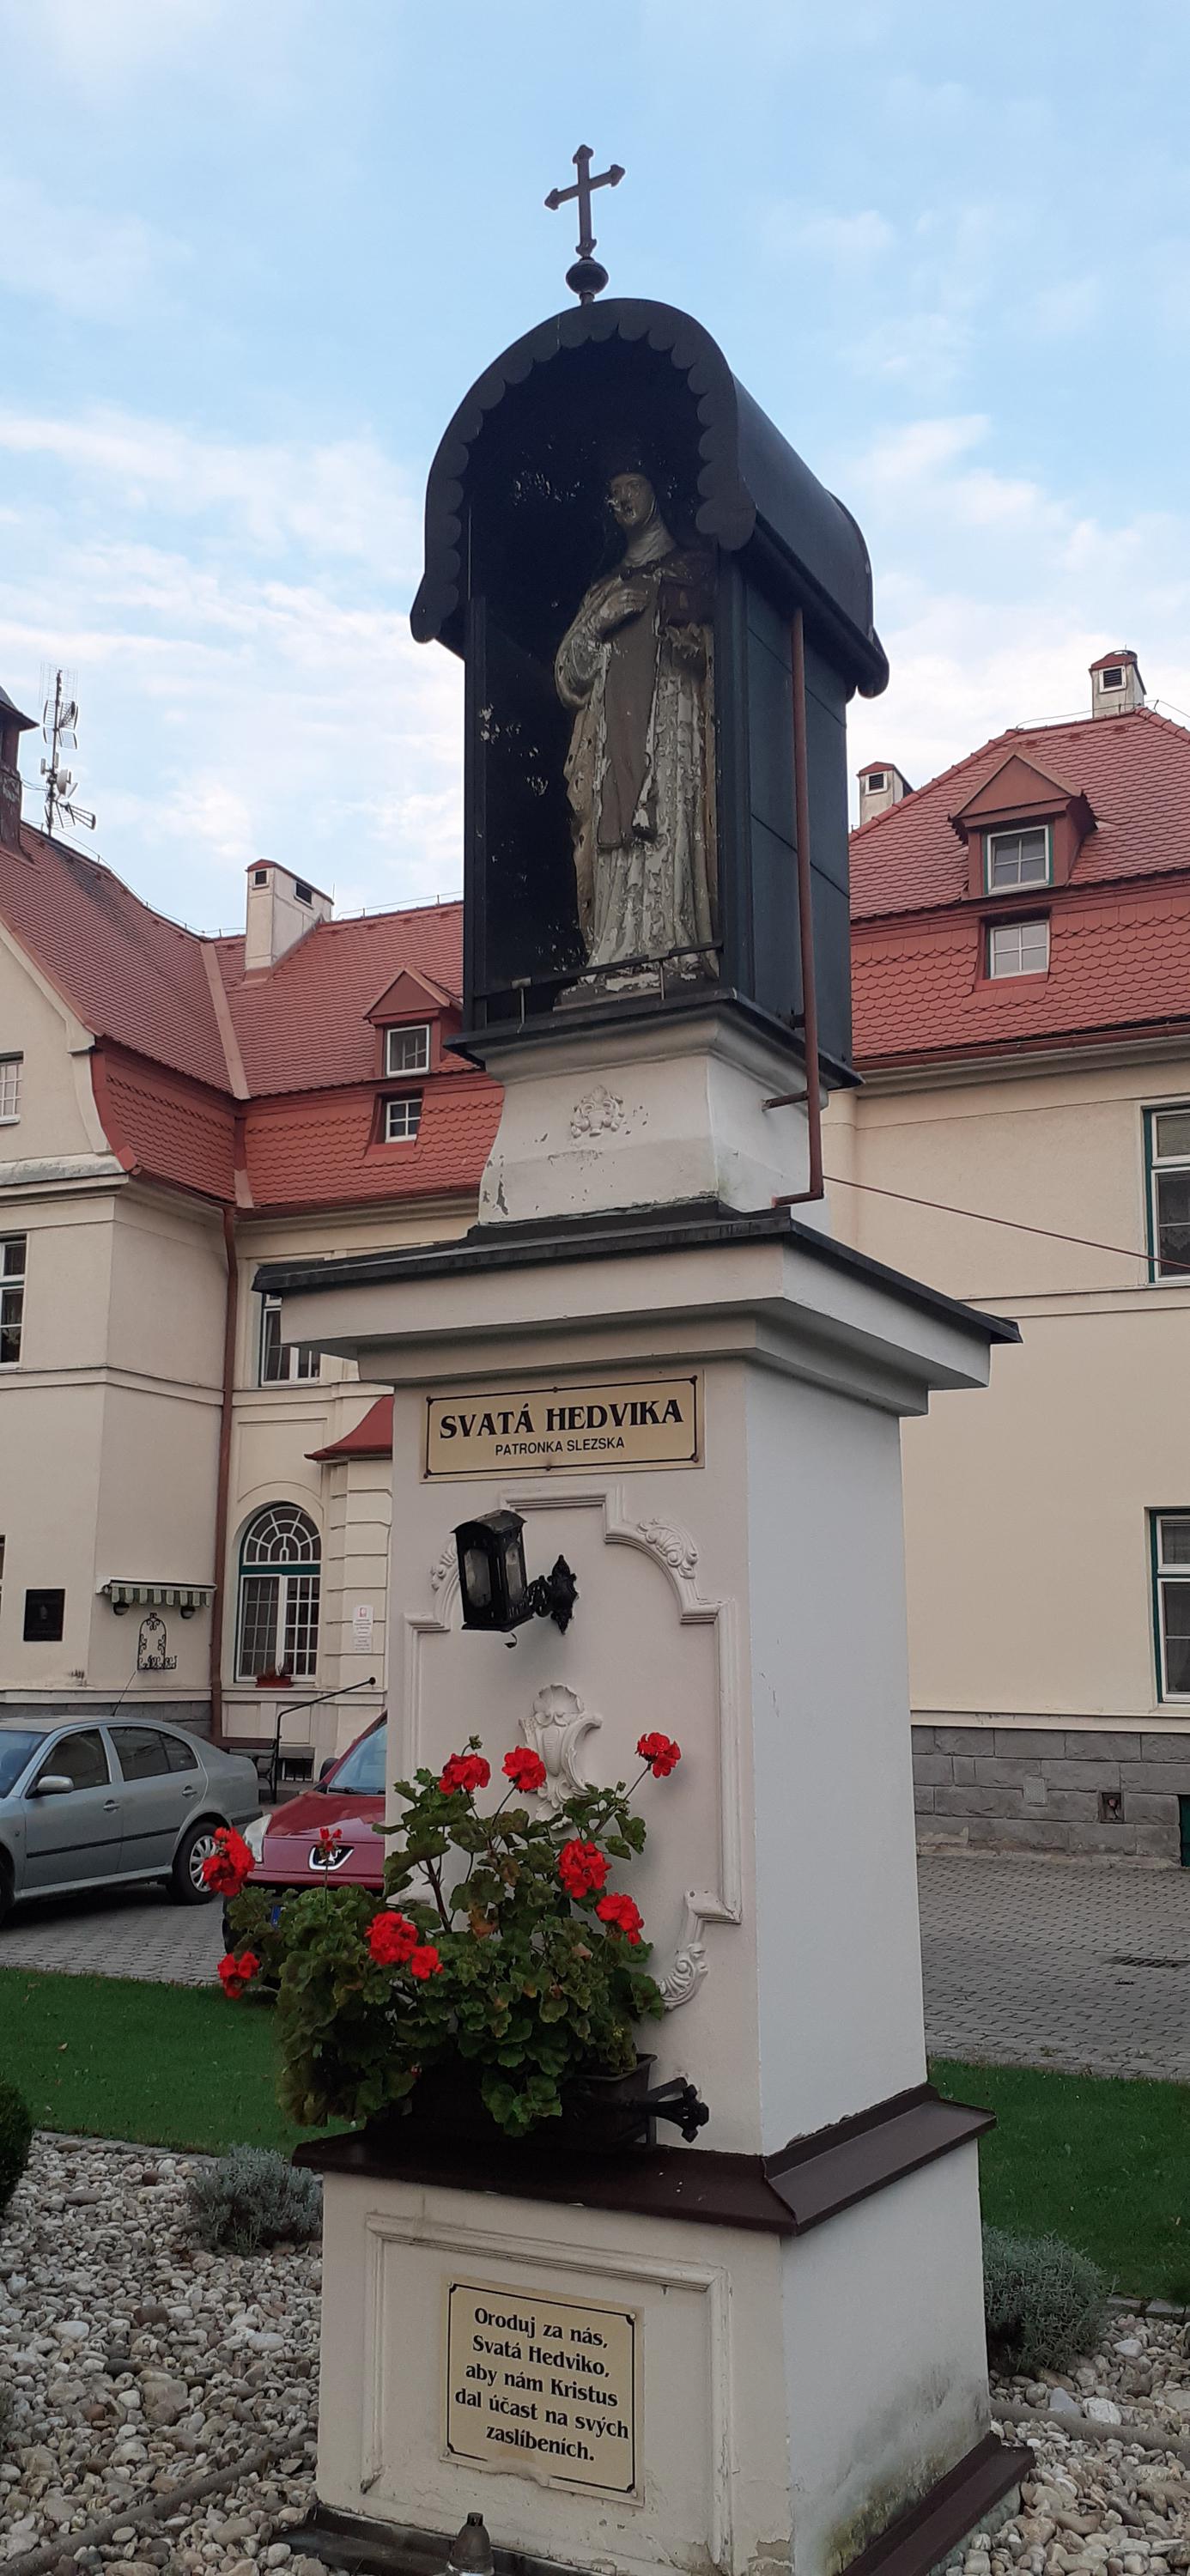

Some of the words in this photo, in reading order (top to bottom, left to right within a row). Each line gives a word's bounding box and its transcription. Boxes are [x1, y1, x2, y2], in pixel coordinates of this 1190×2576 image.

[440, 1403, 535, 1438] SVATÁ
[546, 1399, 683, 1431] HEDVIKA
[495, 1441, 563, 1455] PATRONKA
[567, 1437, 625, 1450] SLEZSKA
[474, 2307, 536, 2338] Oroduj
[543, 2324, 563, 2339] za
[570, 2327, 608, 2348] nás,
[472, 2335, 522, 2359] Svatá
[529, 2346, 610, 2377] Hedviko,
[465, 2363, 497, 2386] aby
[504, 2371, 543, 2391] nám
[550, 2379, 618, 2406] Kristus
[455, 2388, 482, 2407] dal
[489, 2394, 538, 2420] účast
[545, 2409, 568, 2426] na
[575, 2415, 628, 2439] svých
[486, 2425, 595, 2460] zaslíbeních.
